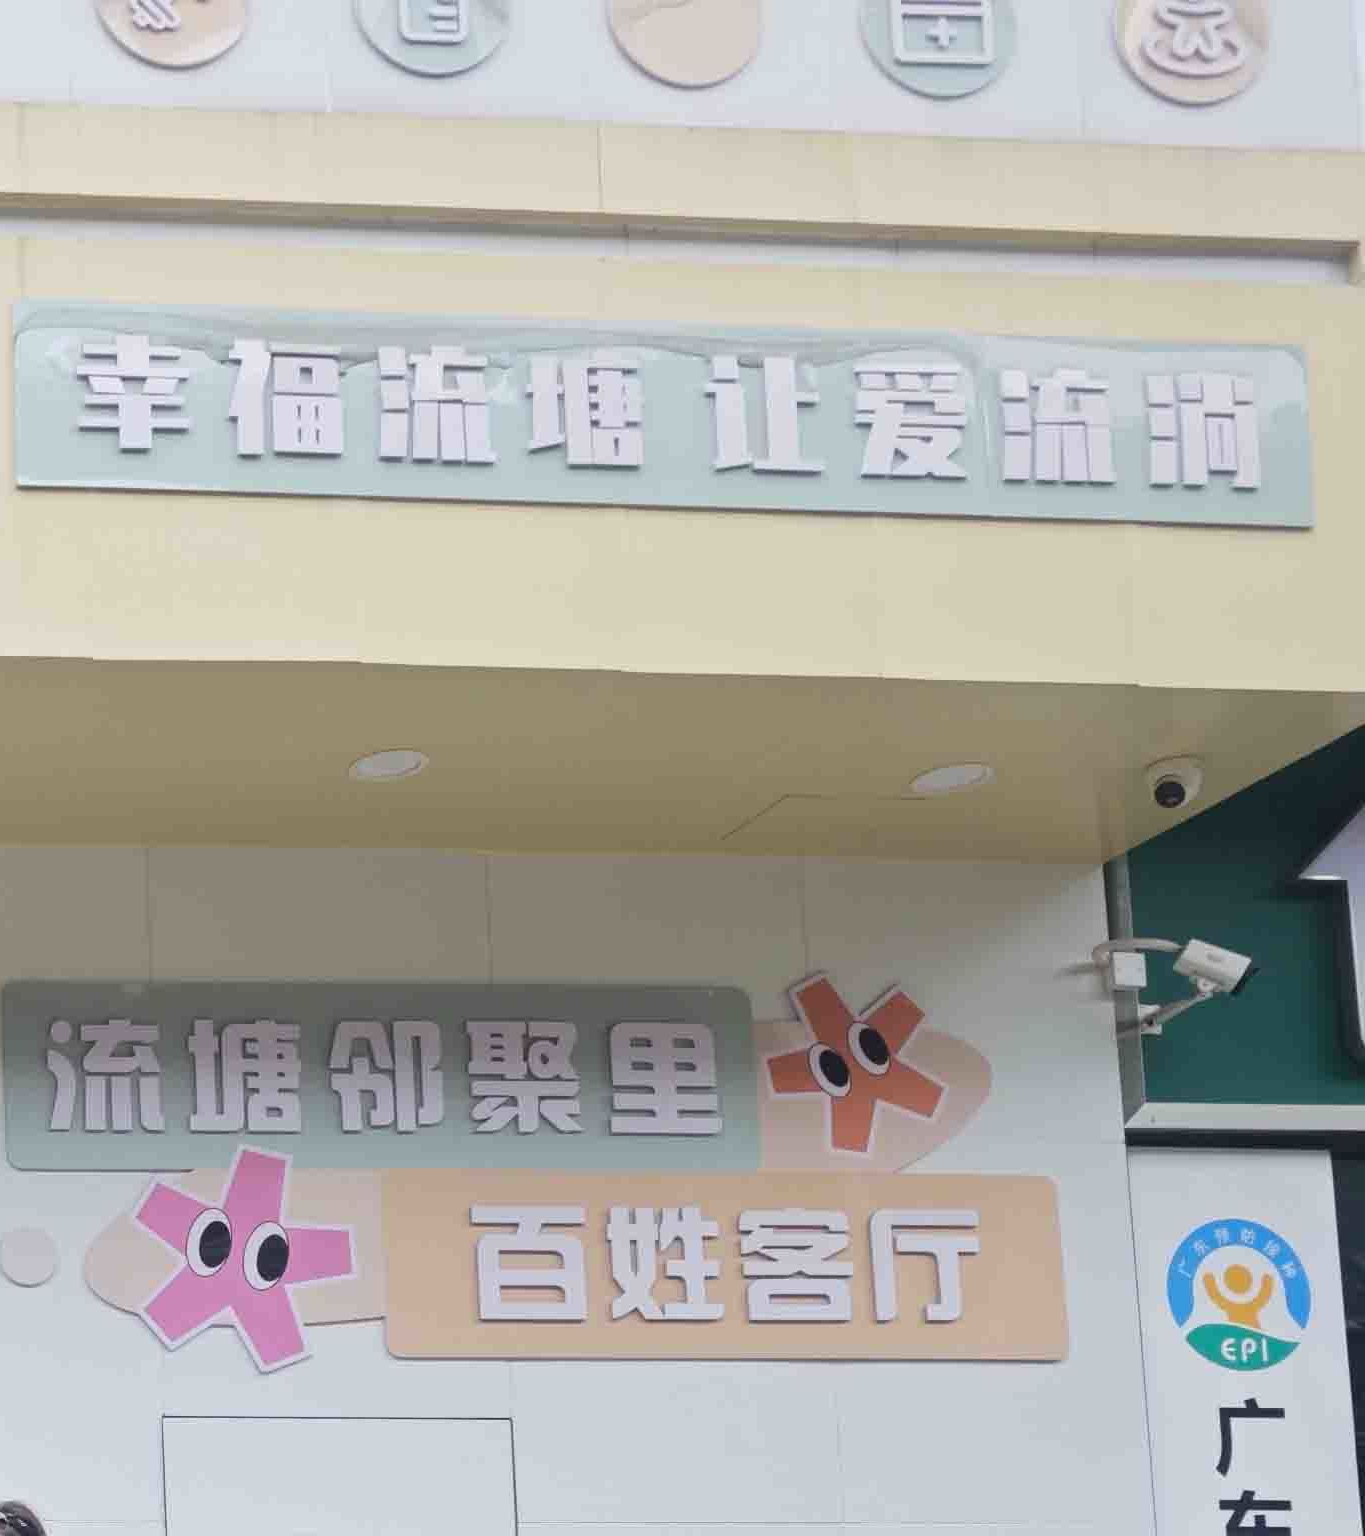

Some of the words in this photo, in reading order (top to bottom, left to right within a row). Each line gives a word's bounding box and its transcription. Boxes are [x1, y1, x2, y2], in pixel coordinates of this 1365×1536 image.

[75, 334, 1263, 490] 幸福流塘让爱流淌
[45, 1018, 726, 1138] 流塘邻聚里
[469, 1205, 984, 1325] 百姓客厅
[1220, 1337, 1269, 1363] EPI
